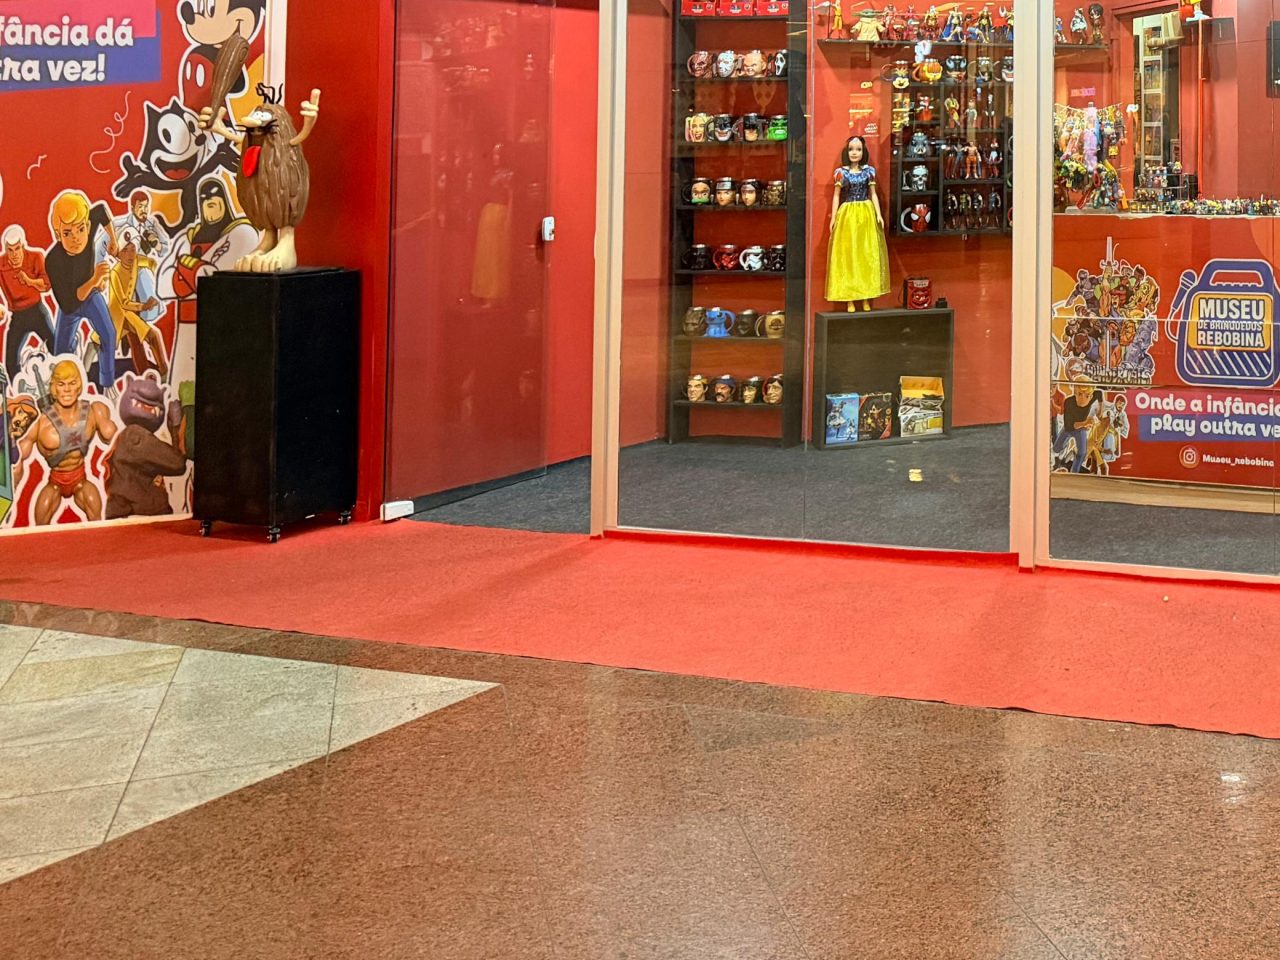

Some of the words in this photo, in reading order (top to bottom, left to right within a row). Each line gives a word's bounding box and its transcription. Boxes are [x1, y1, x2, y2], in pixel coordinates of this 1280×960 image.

[95, 17, 134, 46] dá
[47, 53, 105, 81] vez!
[1199, 298, 1264, 320] MUSEU
[1198, 320, 1208, 329] DE
[1210, 320, 1263, 331] BRINQUEDOS
[1197, 331, 1264, 347] REBOBINA
[1135, 392, 1186, 411] Onde
[1190, 399, 1203, 412] a
[1150, 413, 1196, 437] play
[1200, 419, 1256, 437] outra
[1202, 454, 1275, 468] Museu_rebobina
